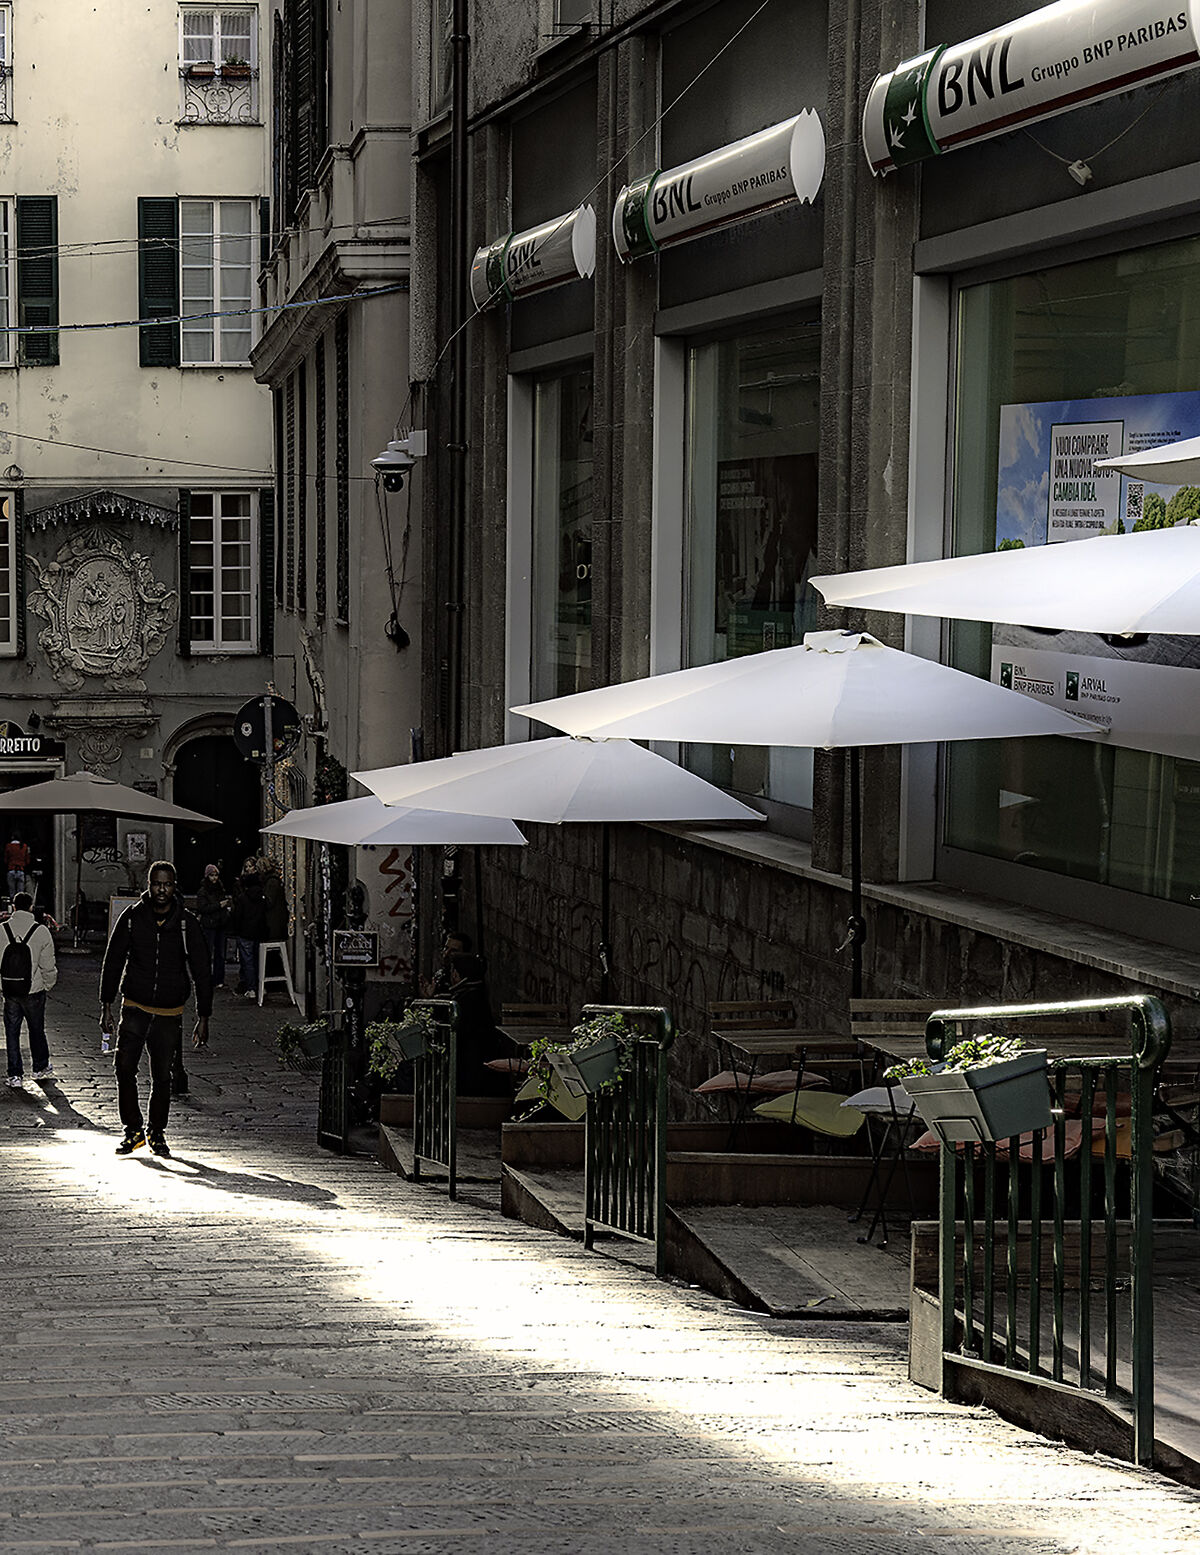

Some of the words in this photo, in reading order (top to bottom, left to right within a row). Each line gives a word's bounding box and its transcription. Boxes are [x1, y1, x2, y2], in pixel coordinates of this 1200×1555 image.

[938, 36, 1025, 118] BNL
[1031, 56, 1079, 83] Gruppo
[1083, 39, 1113, 64] BNP
[1118, 12, 1188, 51] PARIBAS
[653, 175, 702, 225] BNL
[704, 189, 731, 206] Gruppo
[731, 180, 749, 196] BNP
[750, 166, 788, 189] PARIBAS
[508, 239, 542, 277] BNL
[1055, 436, 1071, 456] VUOI
[1072, 434, 1109, 455] COMPRARE
[1054, 458, 1068, 479] UNA
[1069, 458, 1092, 479] NUOVA
[1053, 482, 1080, 502] CAMBIA
[1080, 482, 1097, 502] IDEA.
[1013, 665, 1027, 677] BNL
[1013, 680, 1027, 692] BNP
[1027, 682, 1055, 696] PARIBAS
[1080, 678, 1107, 693] ARVAL
